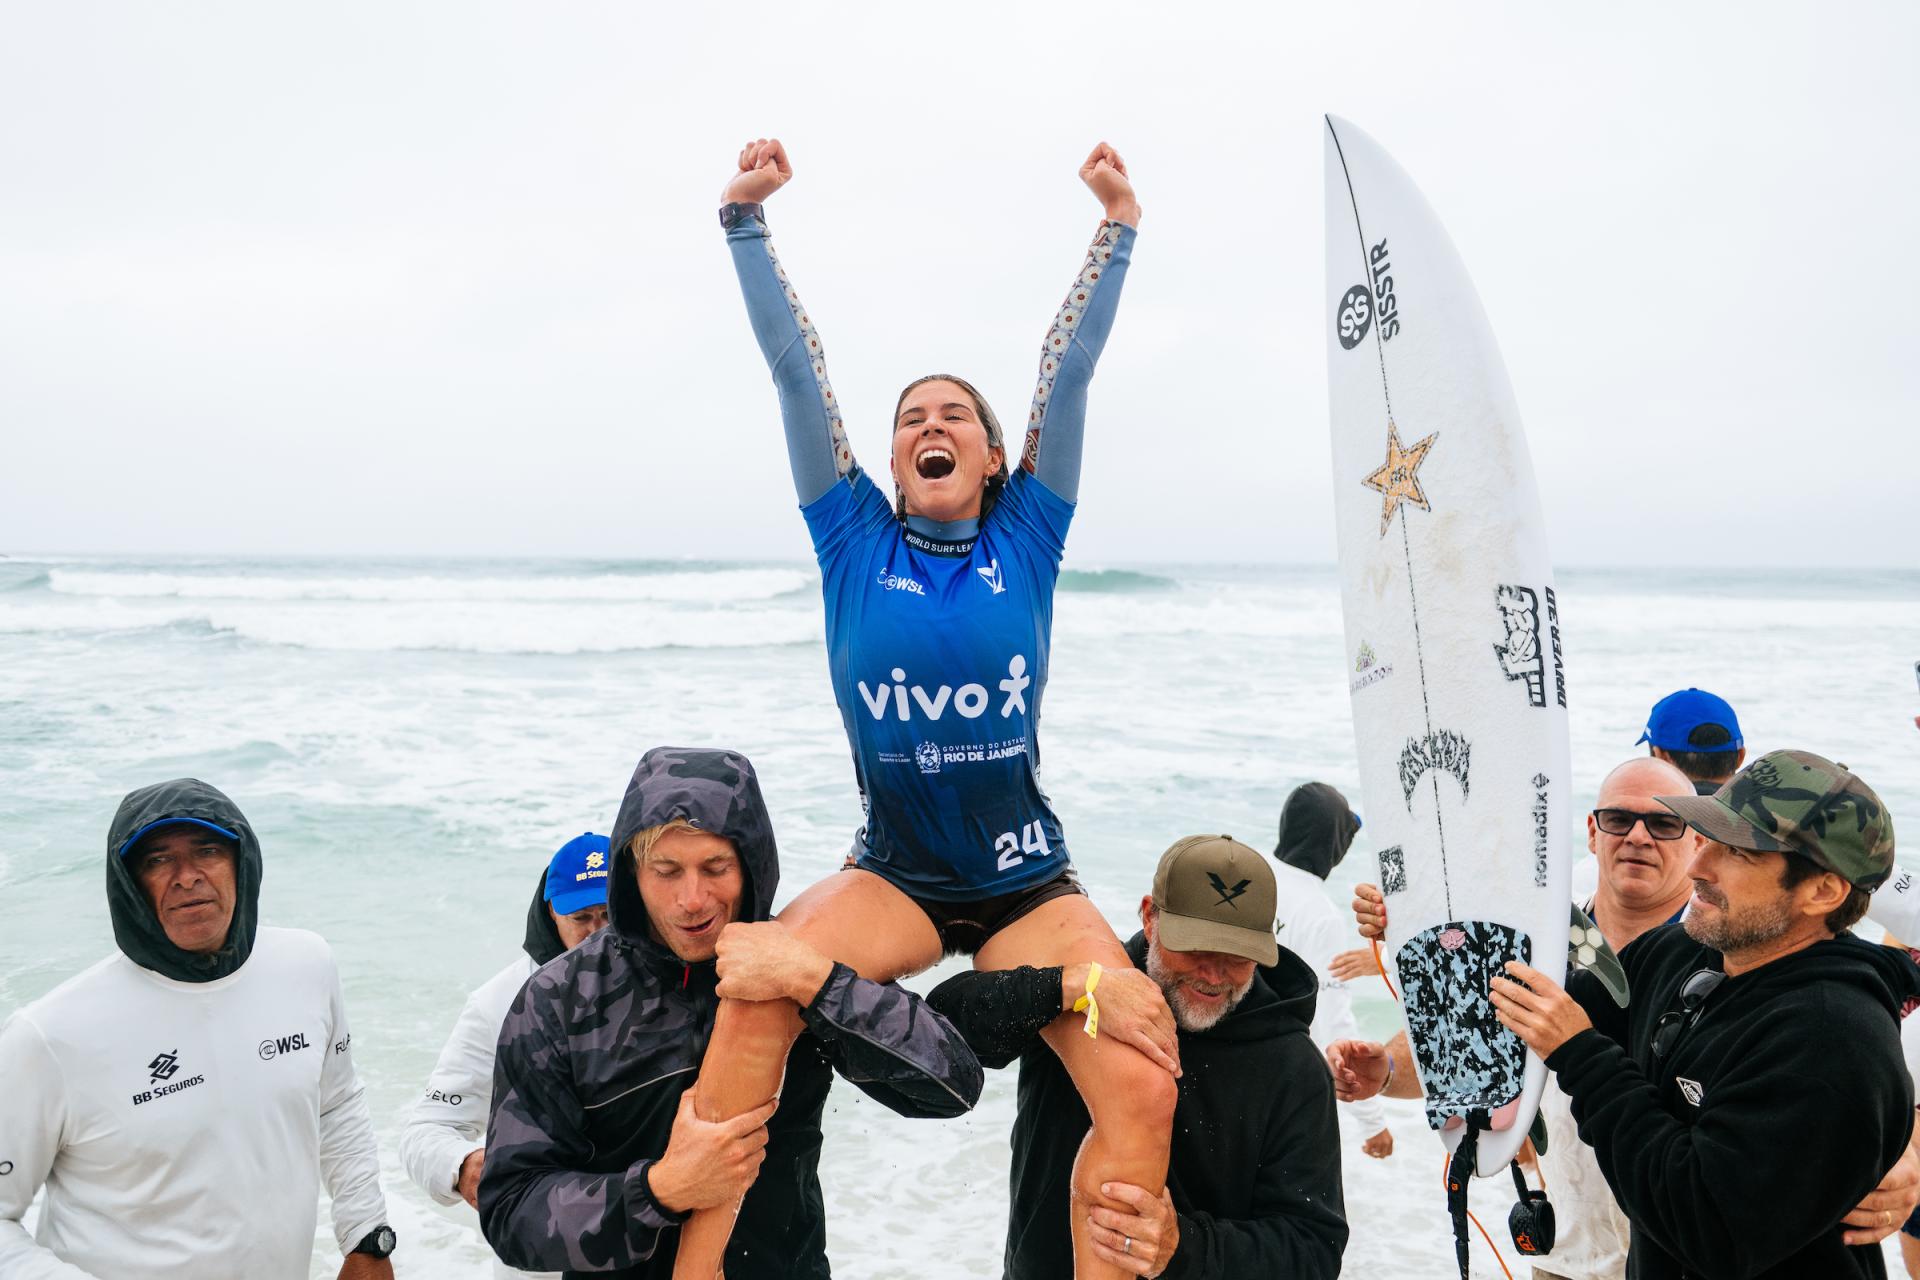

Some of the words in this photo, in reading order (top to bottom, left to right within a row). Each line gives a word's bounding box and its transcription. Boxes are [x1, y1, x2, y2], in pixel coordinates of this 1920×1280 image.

[1370, 237, 1400, 342] SISSTR
[905, 533, 929, 549] WORLD
[930, 543, 954, 553] SURF
[896, 577, 926, 596] WSL
[1550, 625, 1567, 709] DRIVER
[857, 667, 989, 722] vivo
[942, 744, 985, 753] GOVERNO
[943, 752, 966, 764] RIO
[967, 751, 985, 762] DE
[994, 818, 1052, 872] 24
[1532, 791, 1548, 888] nomadix
[276, 1032, 310, 1055] WSL
[132, 1090, 152, 1106] BB
[153, 1074, 205, 1099] SEGUROS
